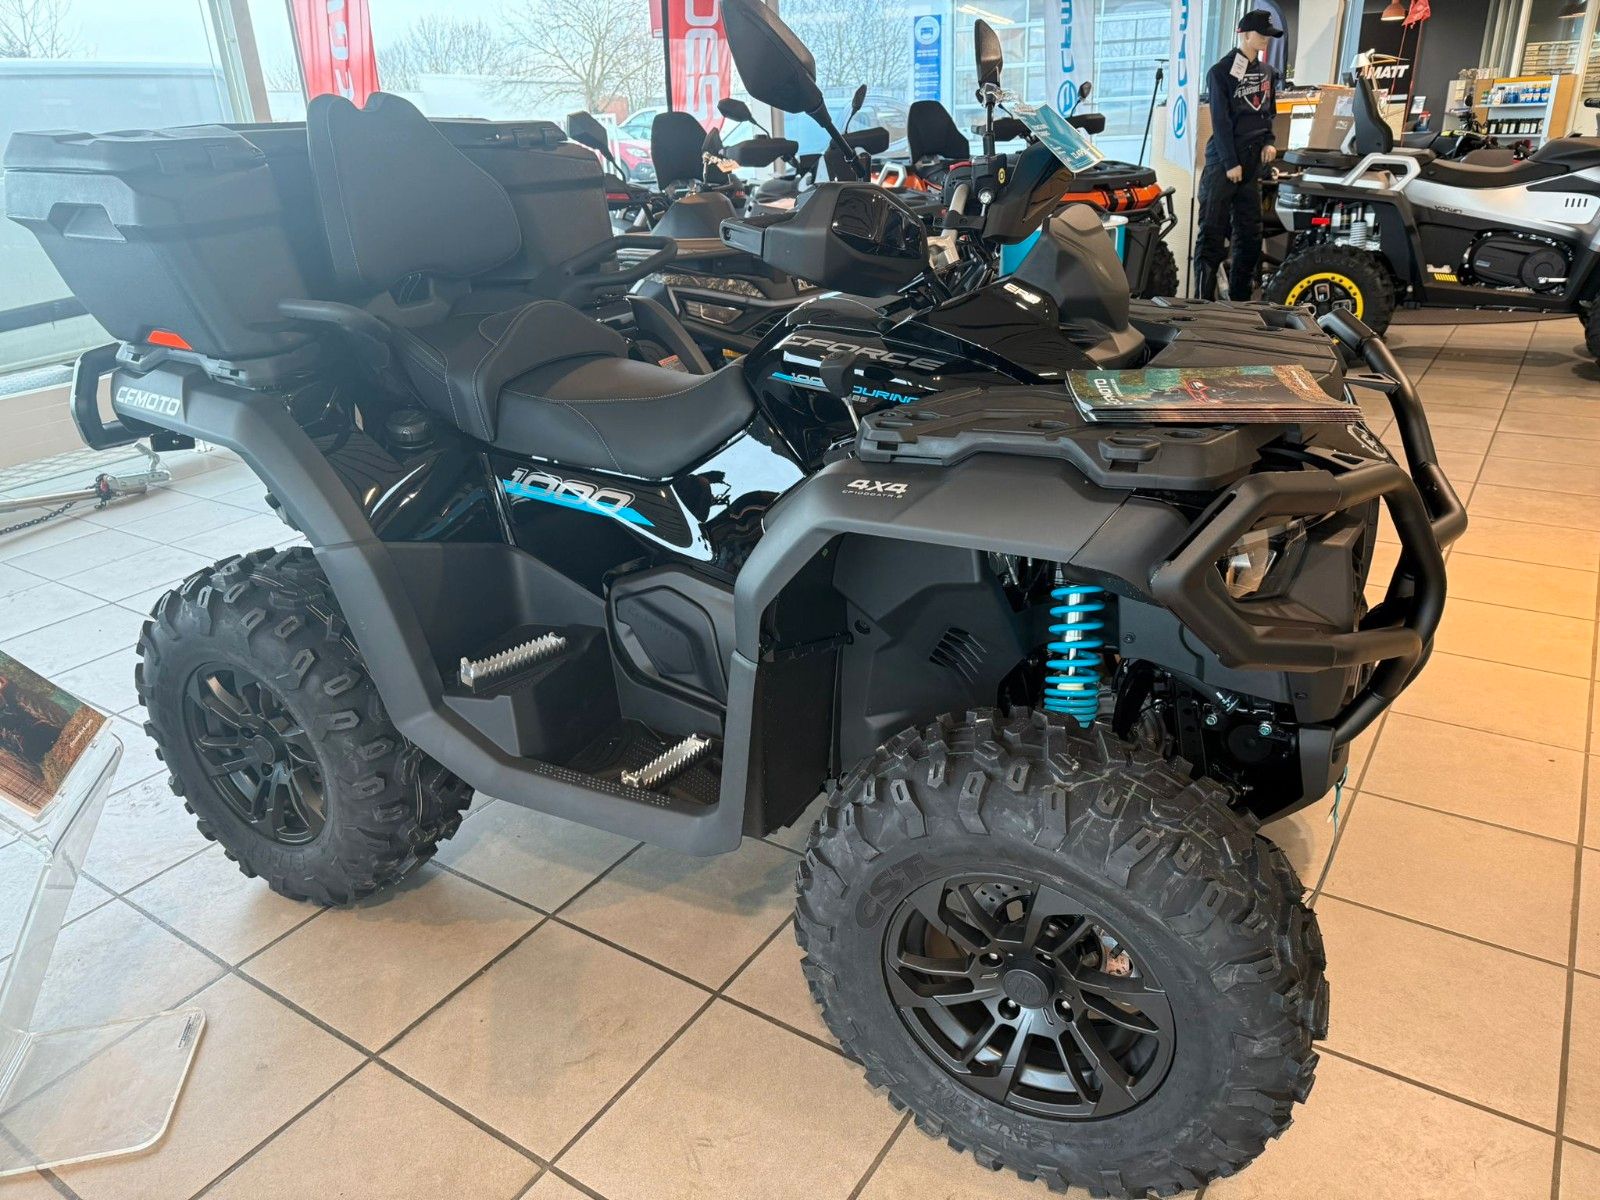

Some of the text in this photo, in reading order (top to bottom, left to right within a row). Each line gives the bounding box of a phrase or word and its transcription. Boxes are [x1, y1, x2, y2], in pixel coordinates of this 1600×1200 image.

[116, 385, 181, 416] CFMOTO
[510, 467, 635, 513] 1000
[855, 852, 926, 929] CST
